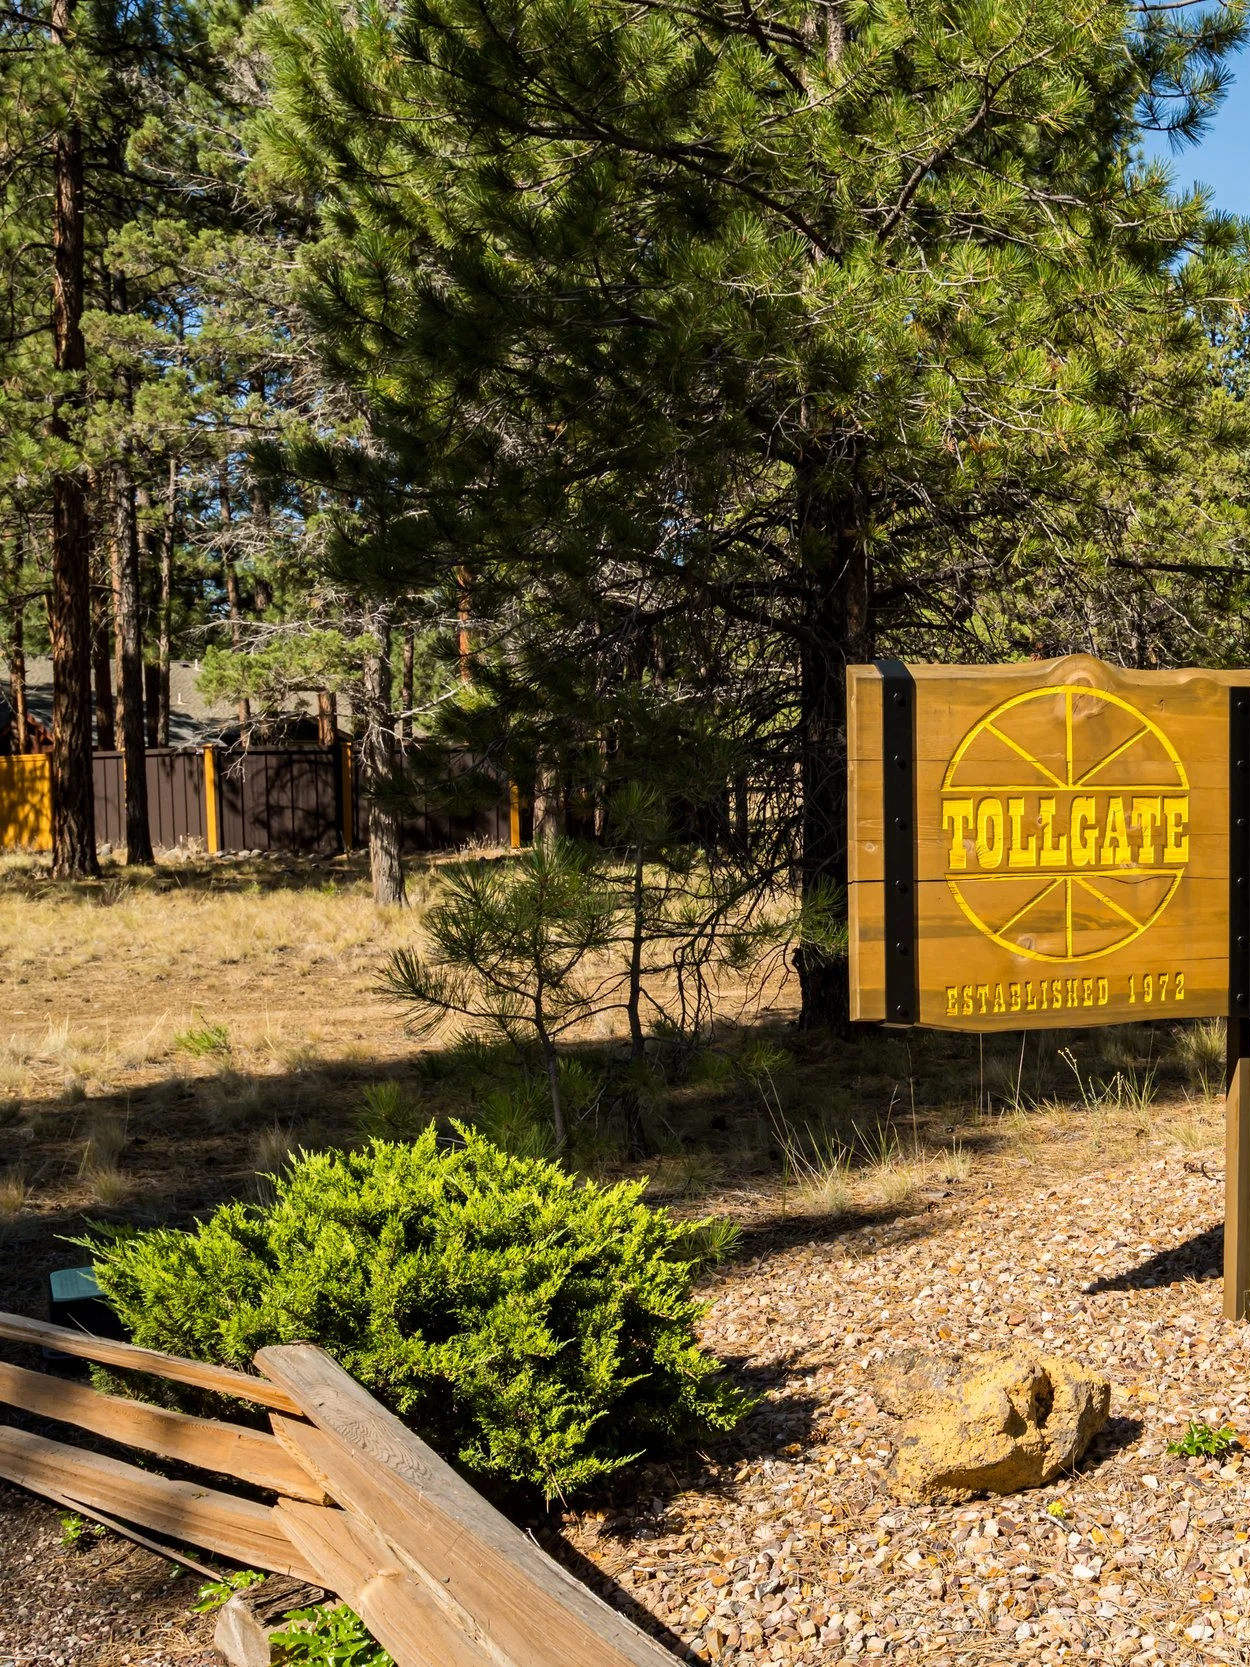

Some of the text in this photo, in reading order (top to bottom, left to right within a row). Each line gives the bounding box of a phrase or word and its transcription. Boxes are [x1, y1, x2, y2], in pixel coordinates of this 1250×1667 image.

[942, 797, 1189, 869] TOLLGATE
[946, 972, 1185, 1016] ESTABLISHED 1972
